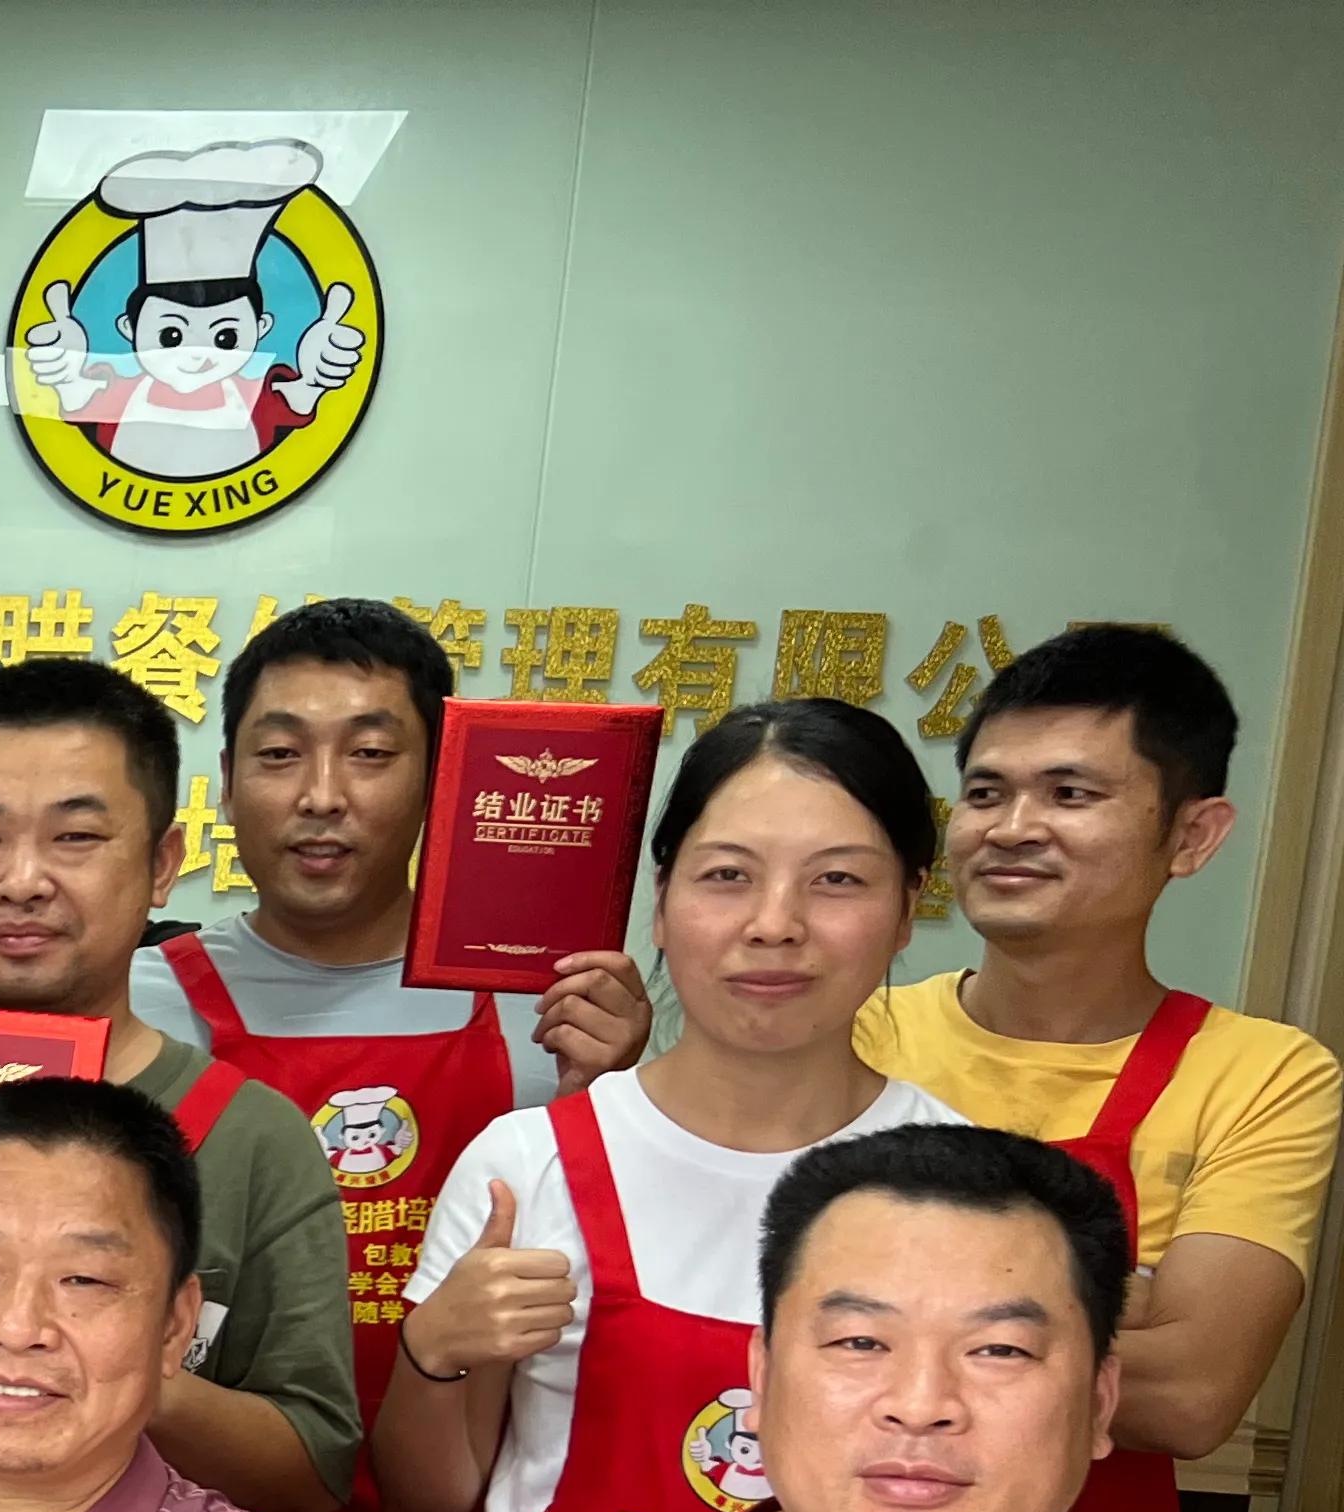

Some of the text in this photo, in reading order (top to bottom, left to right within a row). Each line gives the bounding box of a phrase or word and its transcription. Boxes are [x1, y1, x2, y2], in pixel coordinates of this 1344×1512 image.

[96, 468, 279, 518] YUE XING
[472, 791, 604, 825] 结业证书
[475, 825, 593, 845] CERTIFICATE
